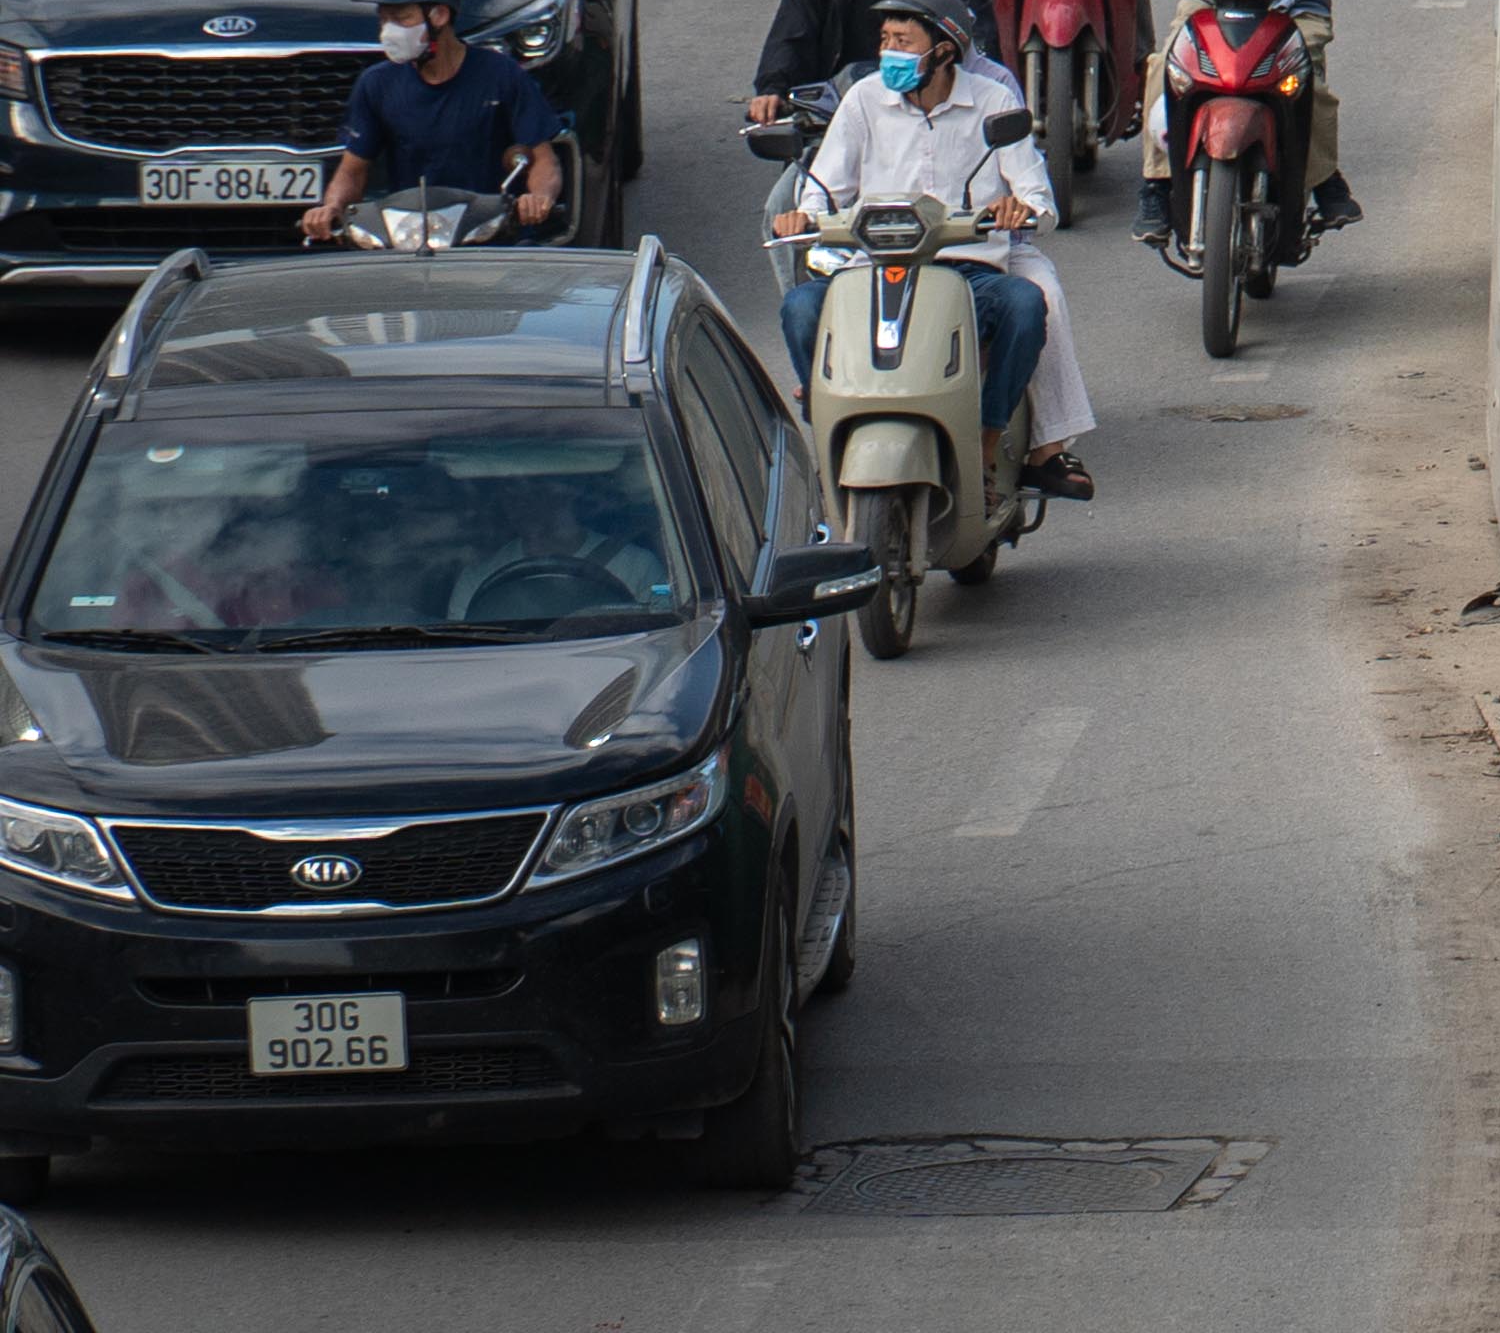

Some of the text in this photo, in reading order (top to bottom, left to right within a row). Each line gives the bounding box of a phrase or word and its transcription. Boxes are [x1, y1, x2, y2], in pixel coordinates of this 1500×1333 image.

[145, 167, 318, 201] 30F-884.22
[303, 861, 352, 882] KIA
[294, 1001, 360, 1033] 30G
[268, 1035, 389, 1069] 902.66
